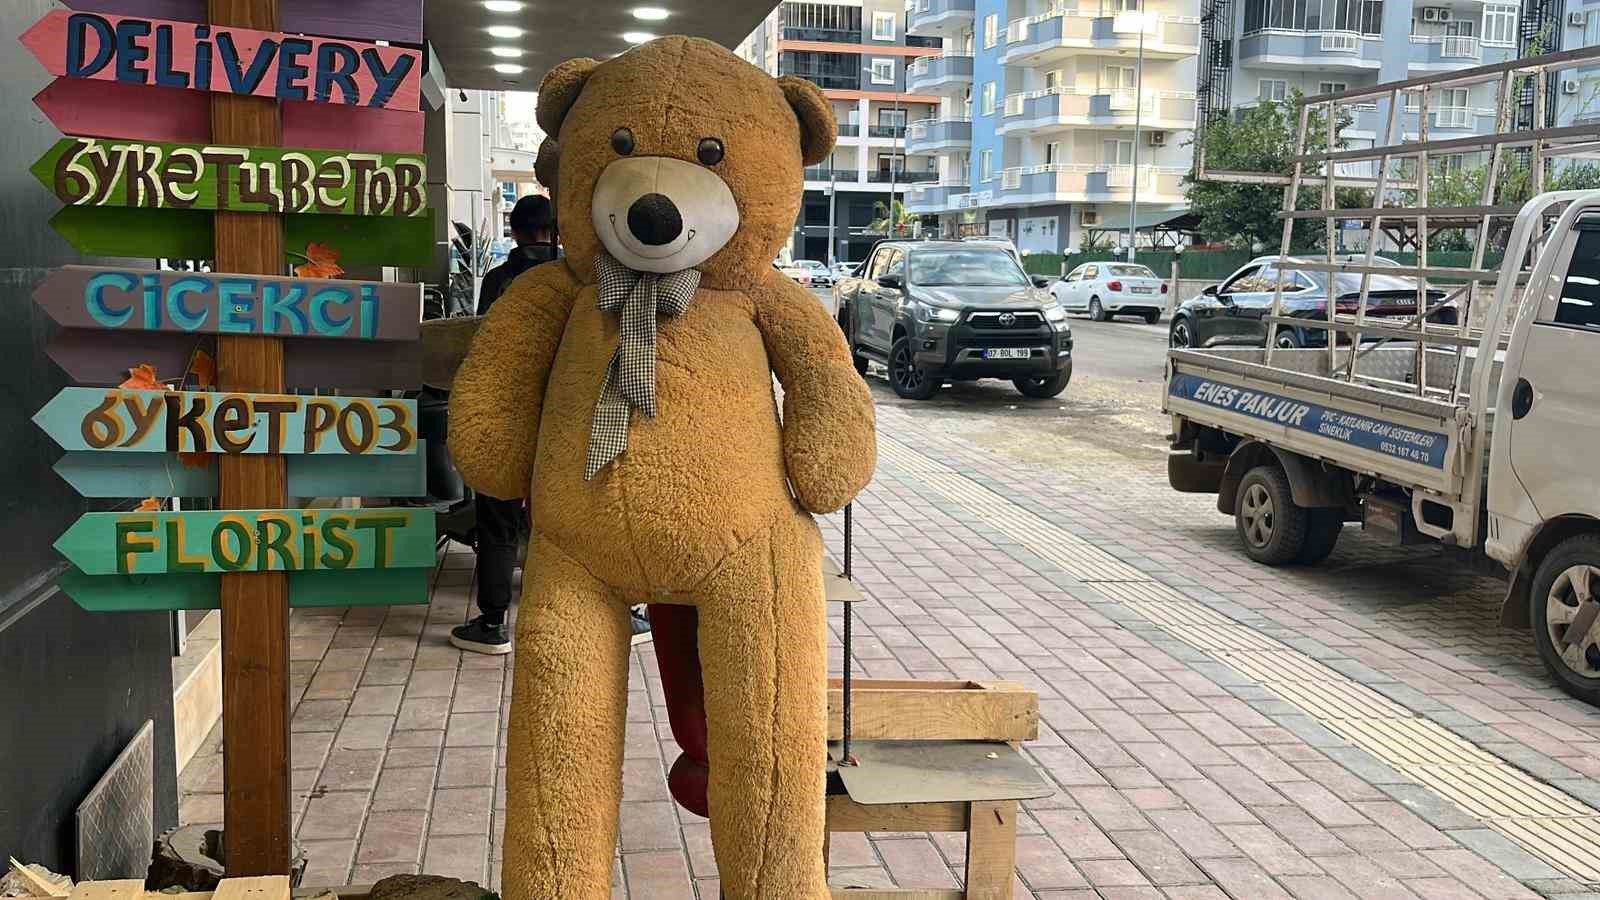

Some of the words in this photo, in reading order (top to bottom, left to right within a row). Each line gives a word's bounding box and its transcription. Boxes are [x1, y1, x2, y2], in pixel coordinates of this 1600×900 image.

[1193, 382, 1239, 407] ENES
[1234, 391, 1310, 426] PANJUR
[1320, 410, 1337, 422] PVC
[1371, 423, 1391, 439] CAM
